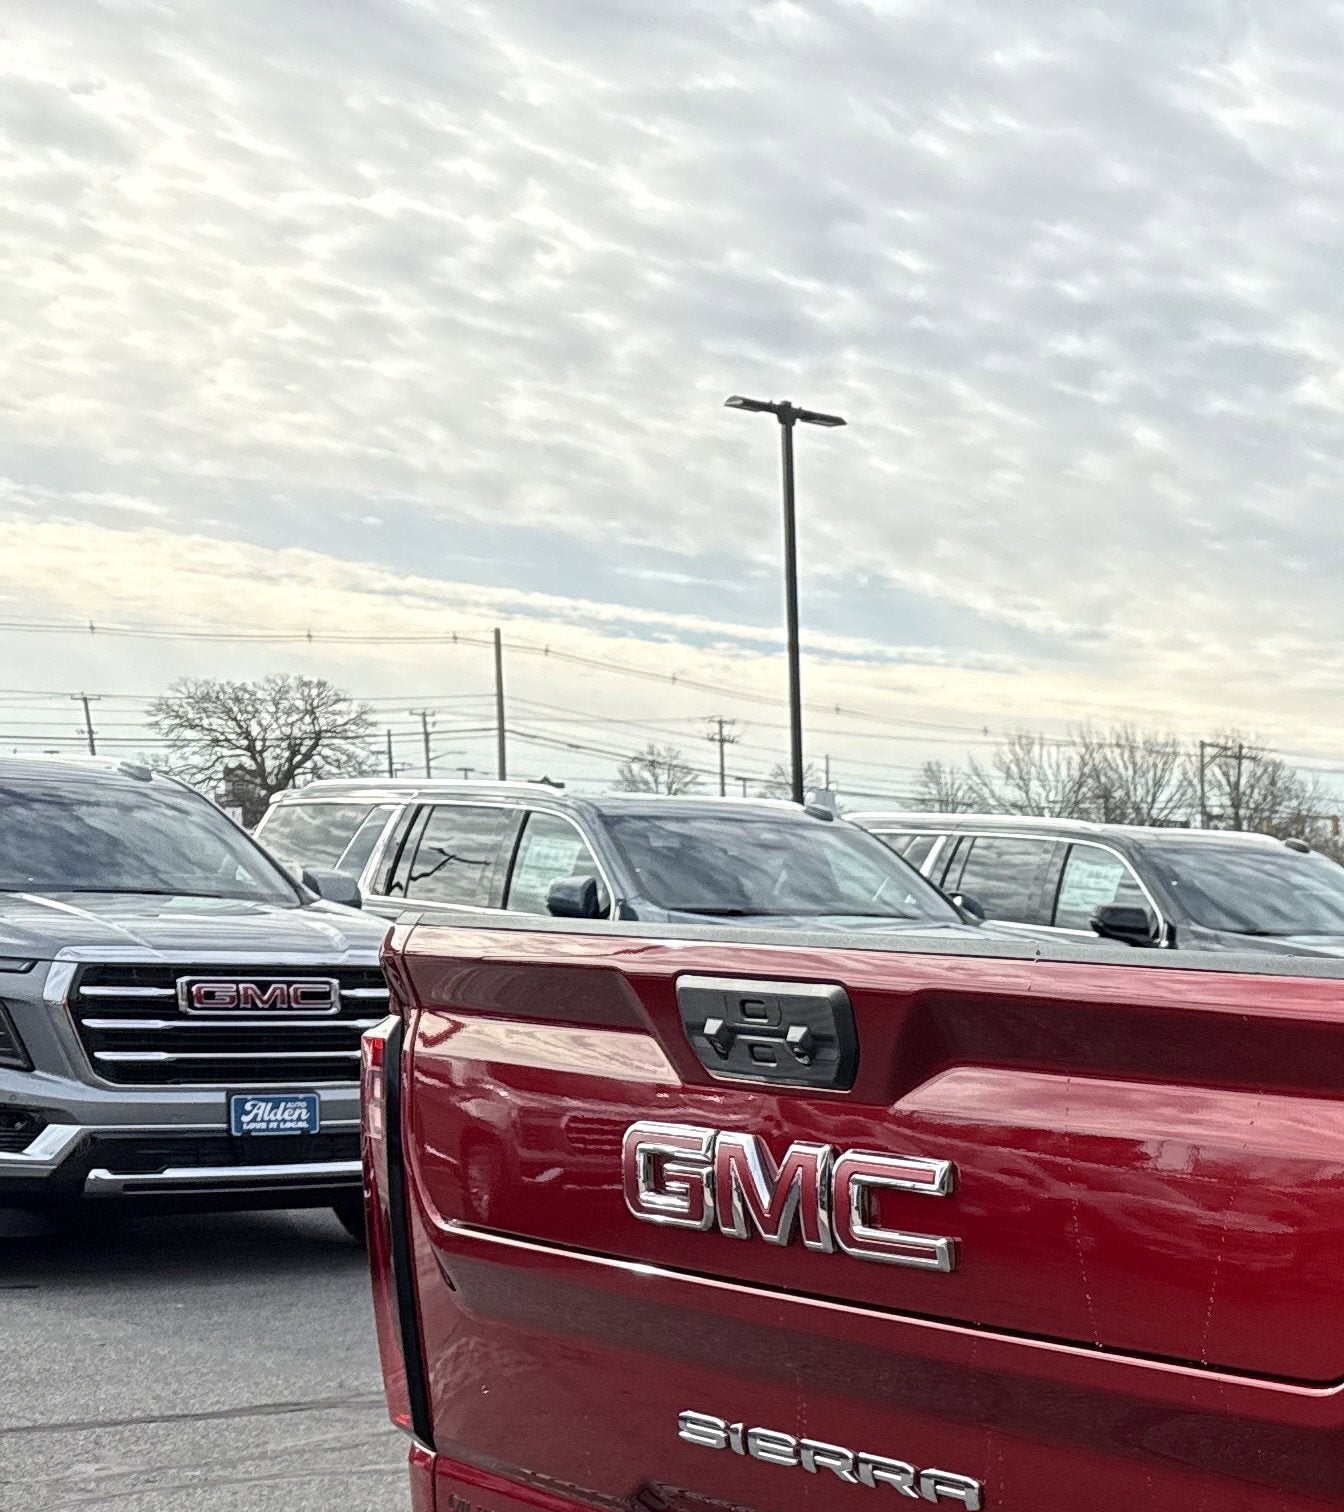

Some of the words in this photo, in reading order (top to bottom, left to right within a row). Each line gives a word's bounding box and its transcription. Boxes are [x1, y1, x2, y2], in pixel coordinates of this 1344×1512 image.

[191, 983, 332, 1009] GMC
[241, 1101, 311, 1122] Alden
[622, 1120, 962, 1273] GMC
[678, 1410, 983, 1512] SIERRA
